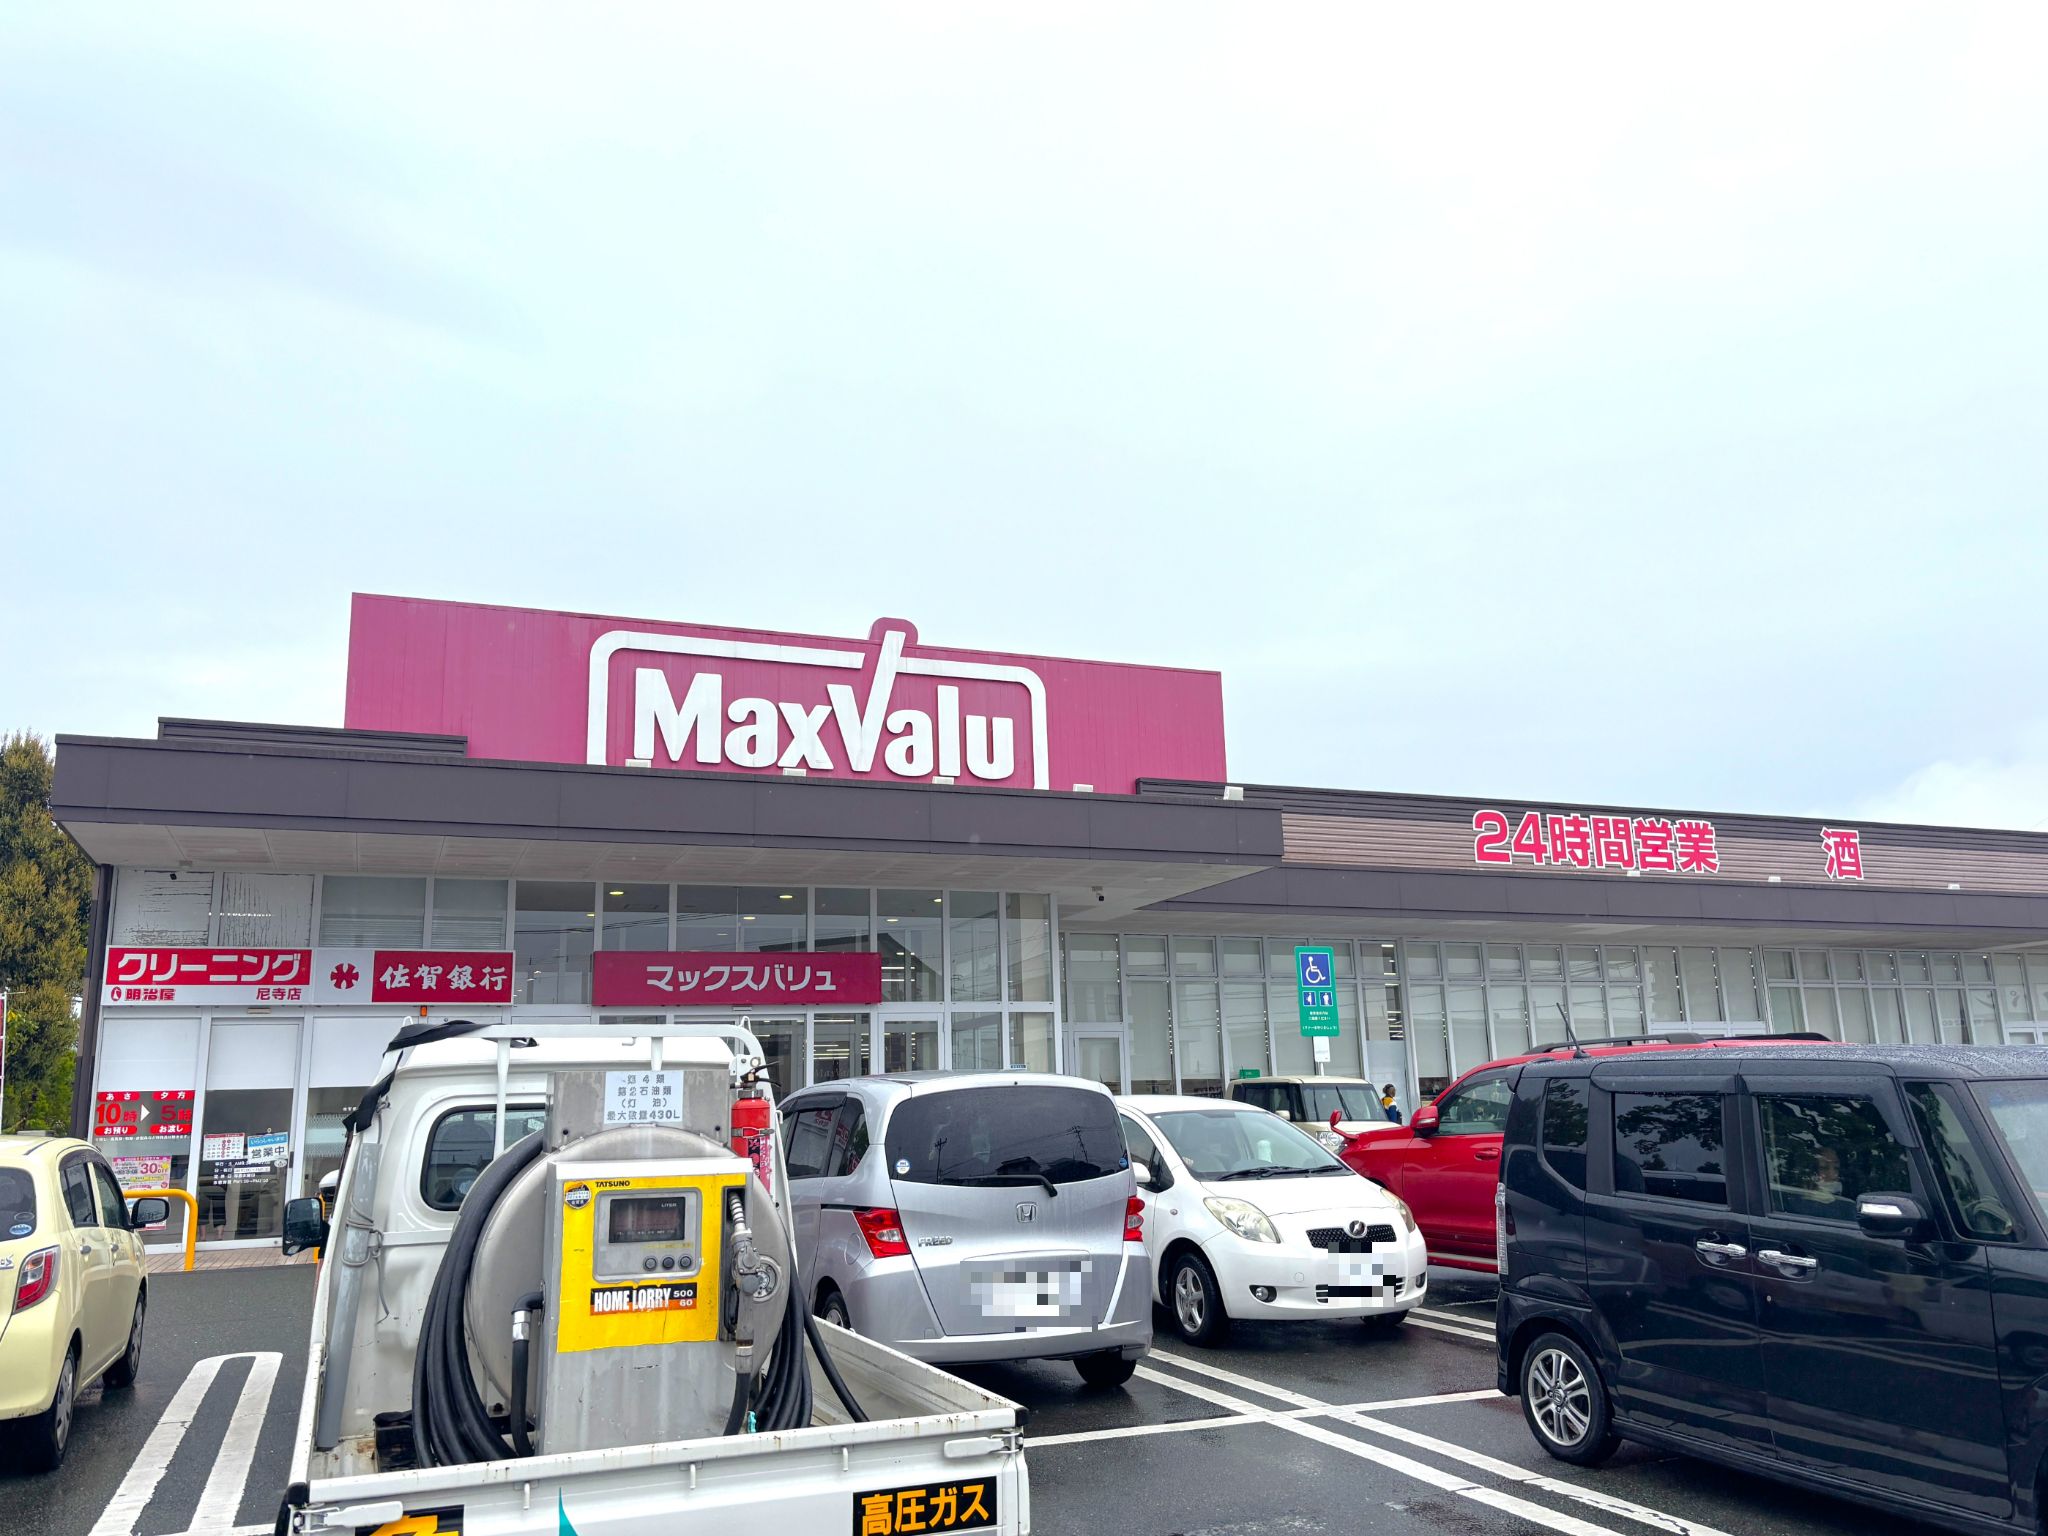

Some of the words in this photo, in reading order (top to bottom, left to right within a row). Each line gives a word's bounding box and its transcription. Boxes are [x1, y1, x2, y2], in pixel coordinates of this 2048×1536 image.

[634, 630, 1014, 779] MaxValu
[1472, 810, 1719, 873] 24時間営業
[1820, 826, 1864, 881] 酒
[118, 953, 301, 982] クリーニング
[379, 963, 508, 991] 佐賀銀行
[646, 964, 836, 991] マックスバリュ
[124, 988, 176, 1001] 明治屋
[256, 987, 302, 1001] 尼寺店
[106, 1093, 131, 1101] あさ
[160, 1091, 186, 1099] 夕方
[96, 1103, 137, 1124] 10時
[104, 1126, 128, 1135] お預り
[159, 1125, 183, 1133] お渡し
[252, 1146, 284, 1158] 営業中
[140, 1162, 158, 1174] 30
[918, 1236, 953, 1247] FREED
[594, 1290, 630, 1312] HOME
[632, 1288, 671, 1311] LORRY
[861, 1484, 989, 1536] 高圧ガス
